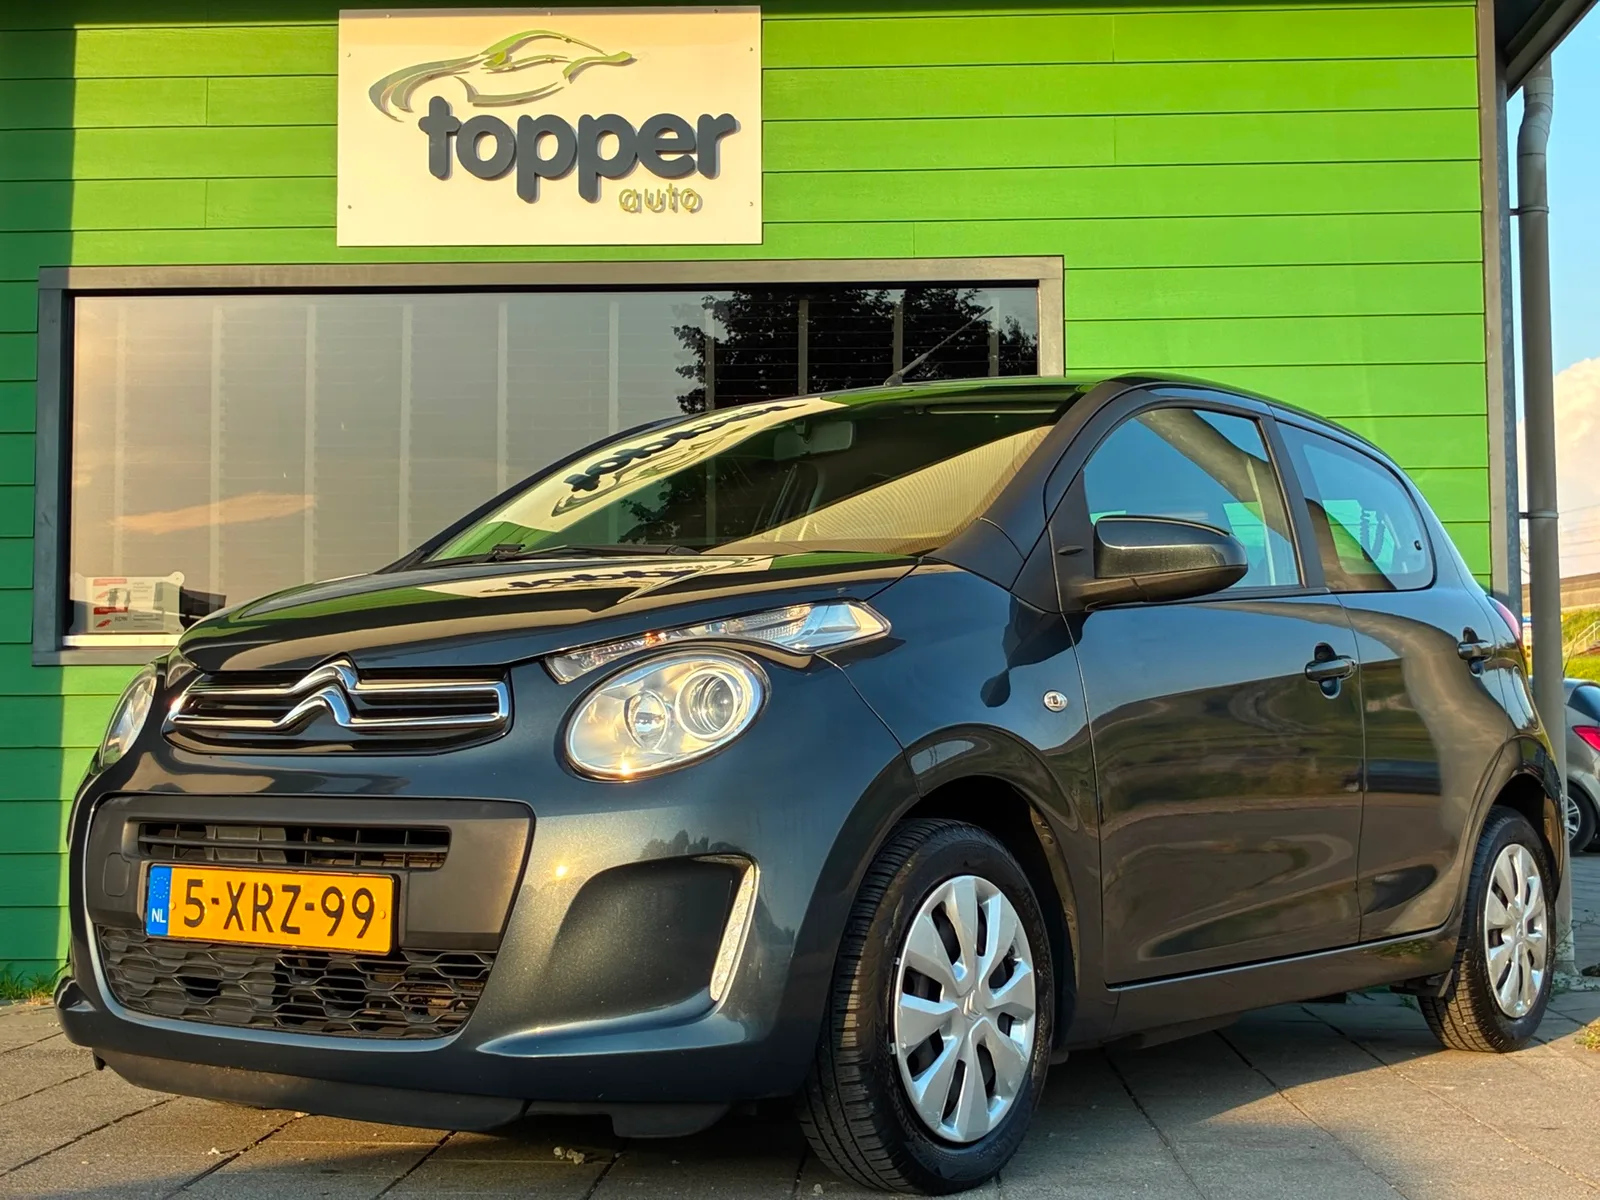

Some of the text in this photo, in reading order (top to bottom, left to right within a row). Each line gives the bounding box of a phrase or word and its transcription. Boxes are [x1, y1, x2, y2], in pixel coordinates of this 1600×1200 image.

[418, 96, 739, 203] topper
[619, 183, 701, 212] auto
[151, 908, 166, 924] NL
[184, 879, 375, 939] 5-XRZ-99
